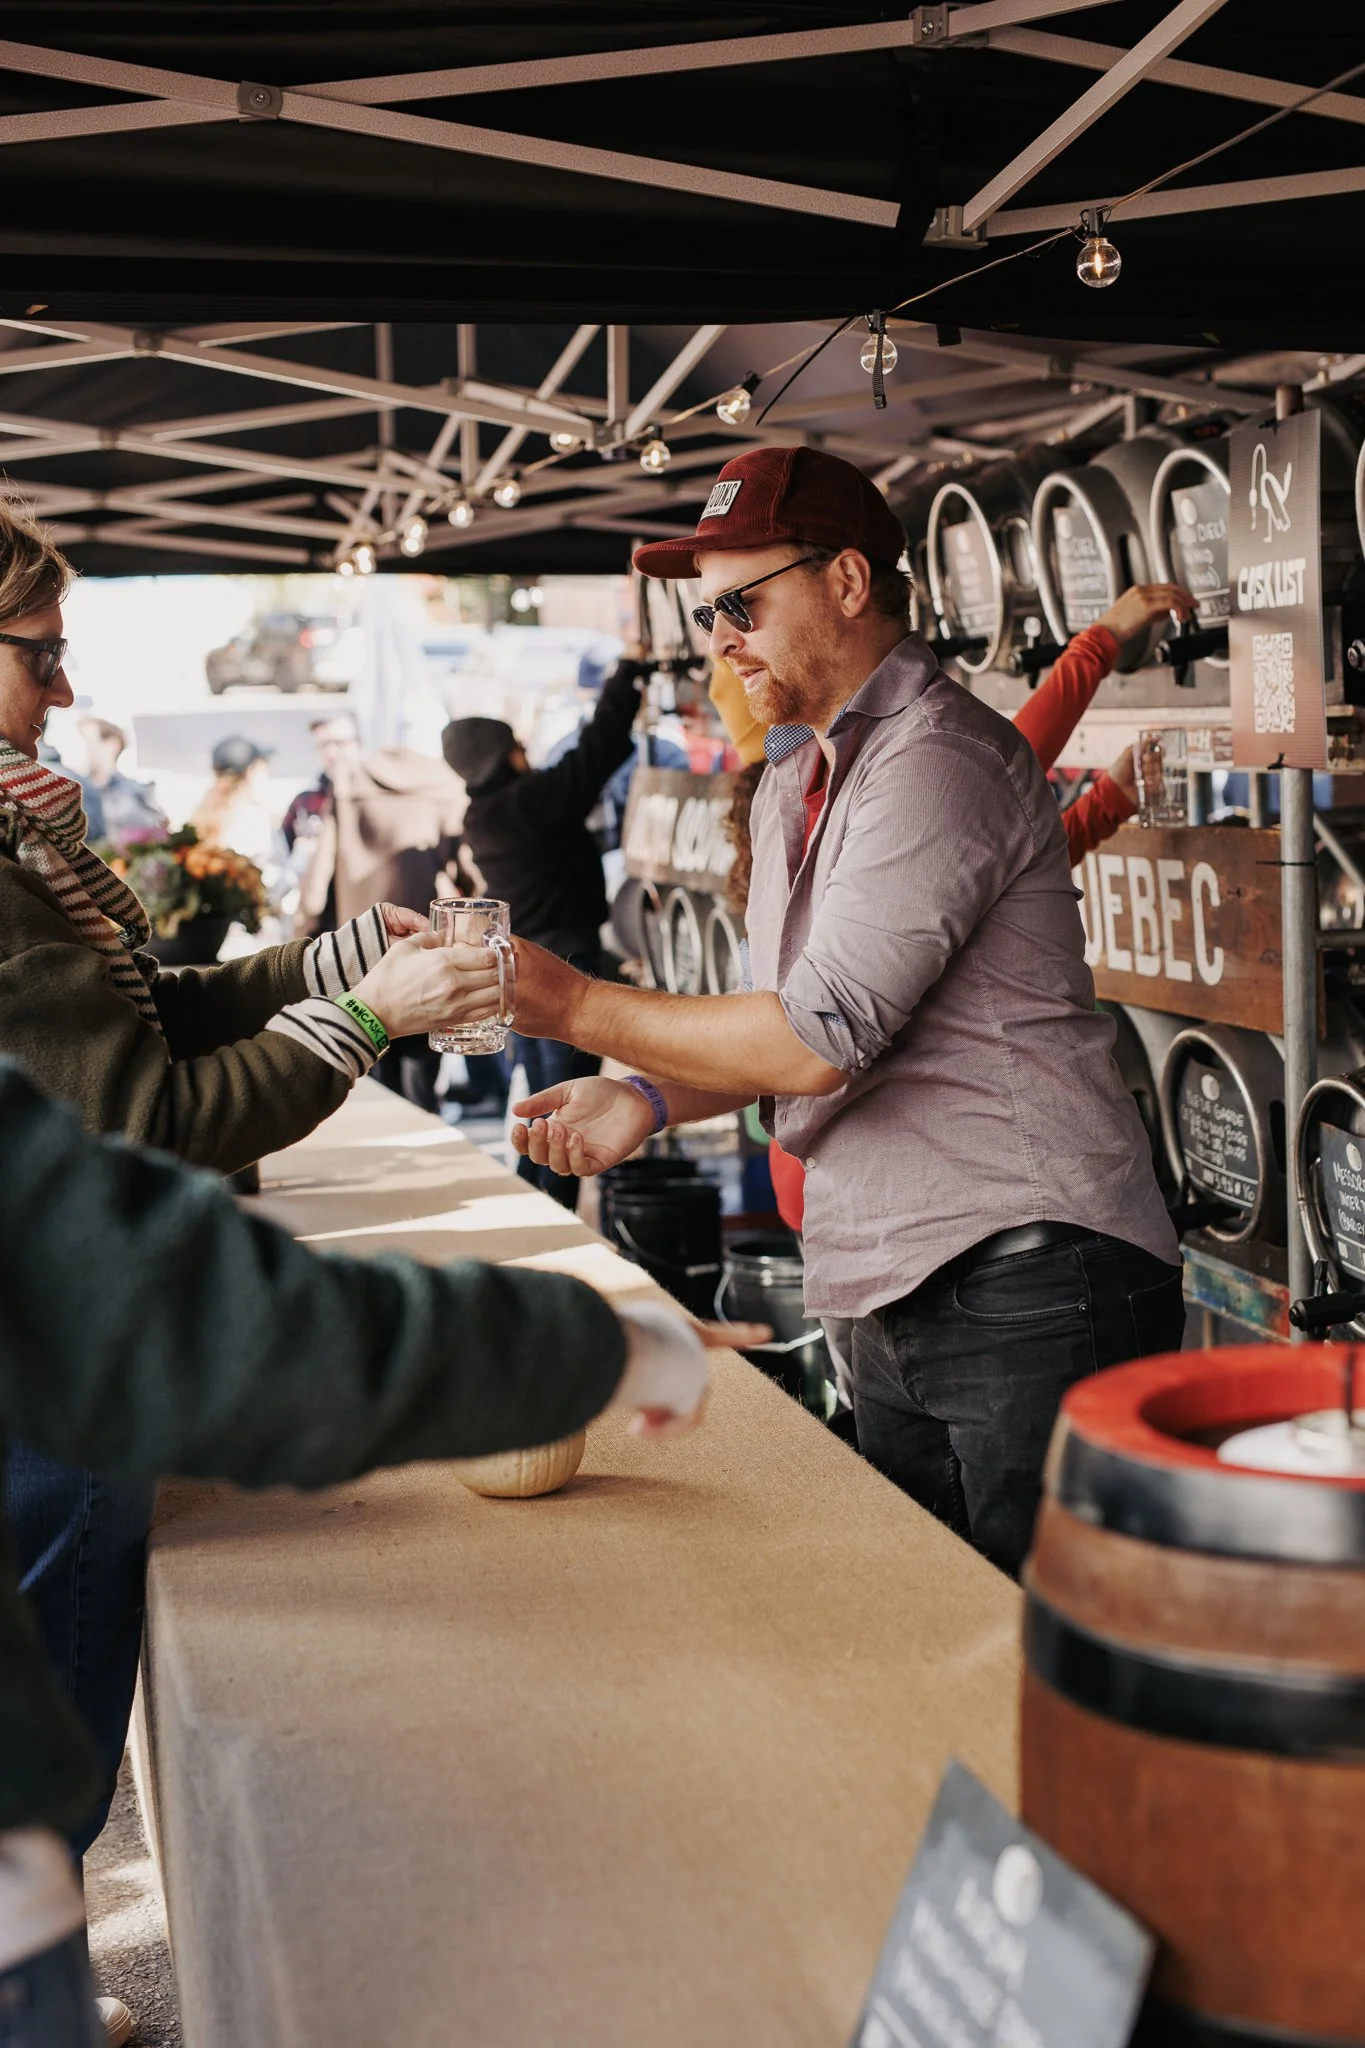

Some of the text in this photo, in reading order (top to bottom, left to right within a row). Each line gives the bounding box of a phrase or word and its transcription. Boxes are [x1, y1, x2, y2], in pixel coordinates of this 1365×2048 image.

[1237, 562, 1276, 612] CASK
[1274, 557, 1306, 608] LIST
[1071, 851, 1225, 986] UEBEC
[345, 998, 383, 1040] #ONCASK
